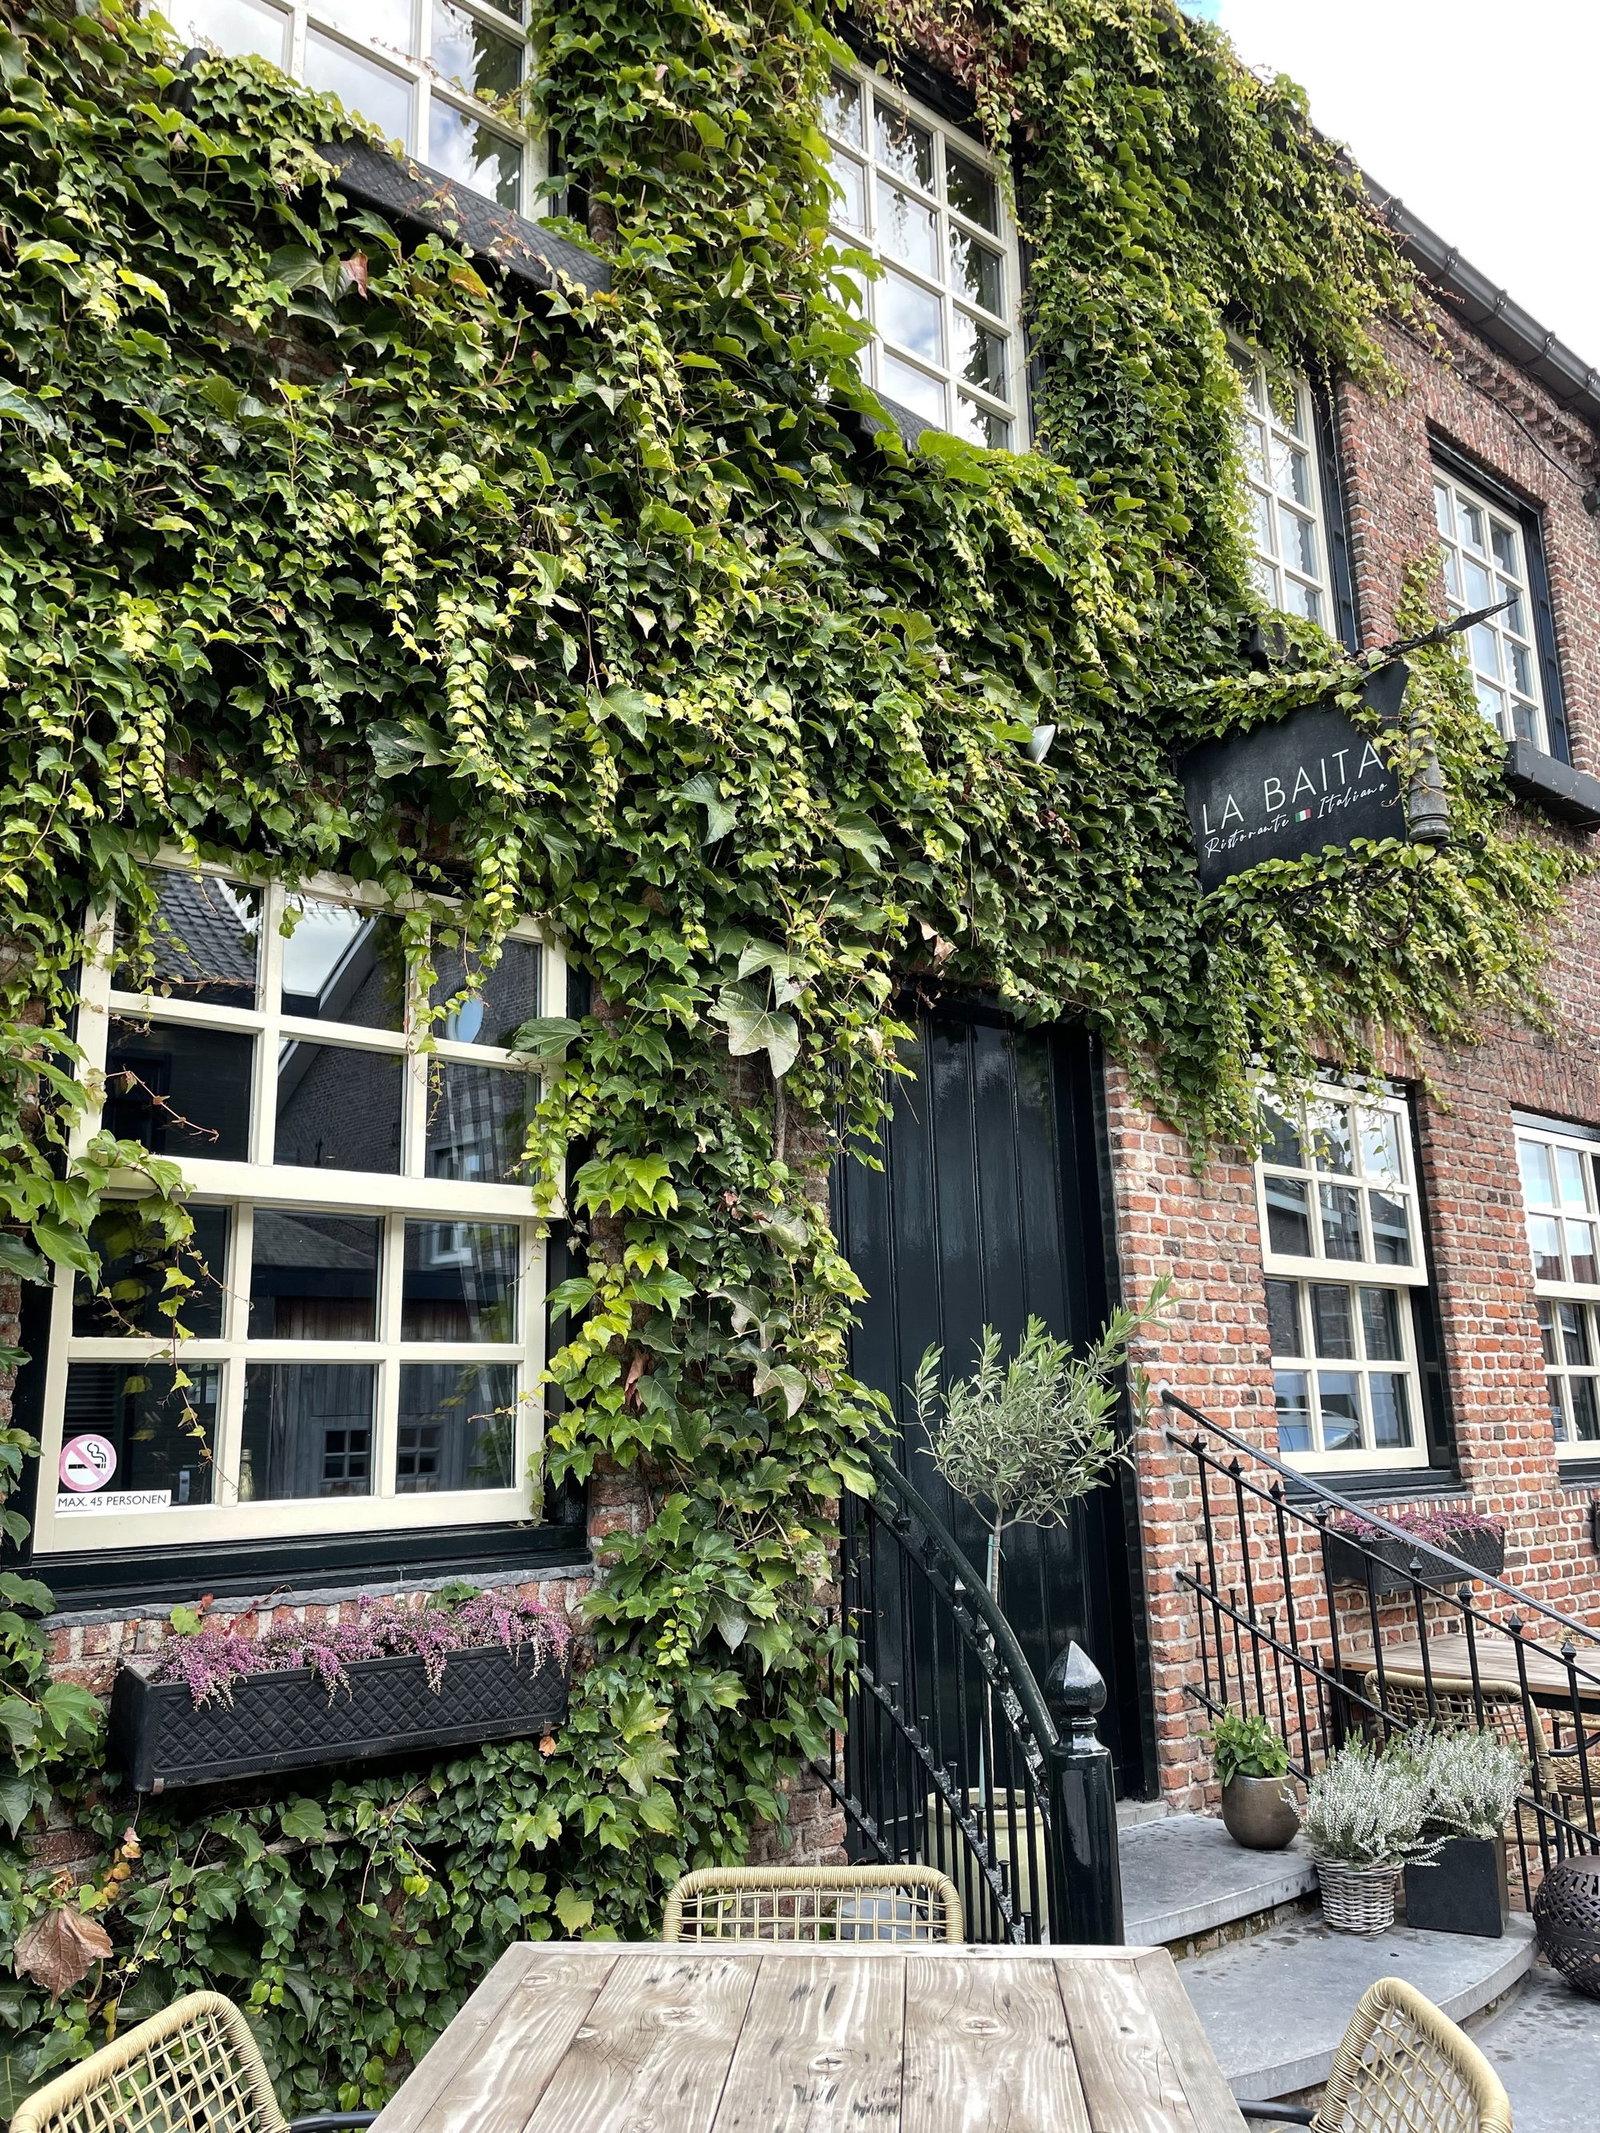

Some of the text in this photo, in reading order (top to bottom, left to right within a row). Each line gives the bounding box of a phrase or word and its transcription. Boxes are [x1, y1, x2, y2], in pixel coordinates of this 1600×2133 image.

[1202, 740, 1385, 836] LA BAITA
[1203, 781, 1388, 859] Ristorante Italiano
[57, 1494, 167, 1508] MAX. 45 PERSONEN
